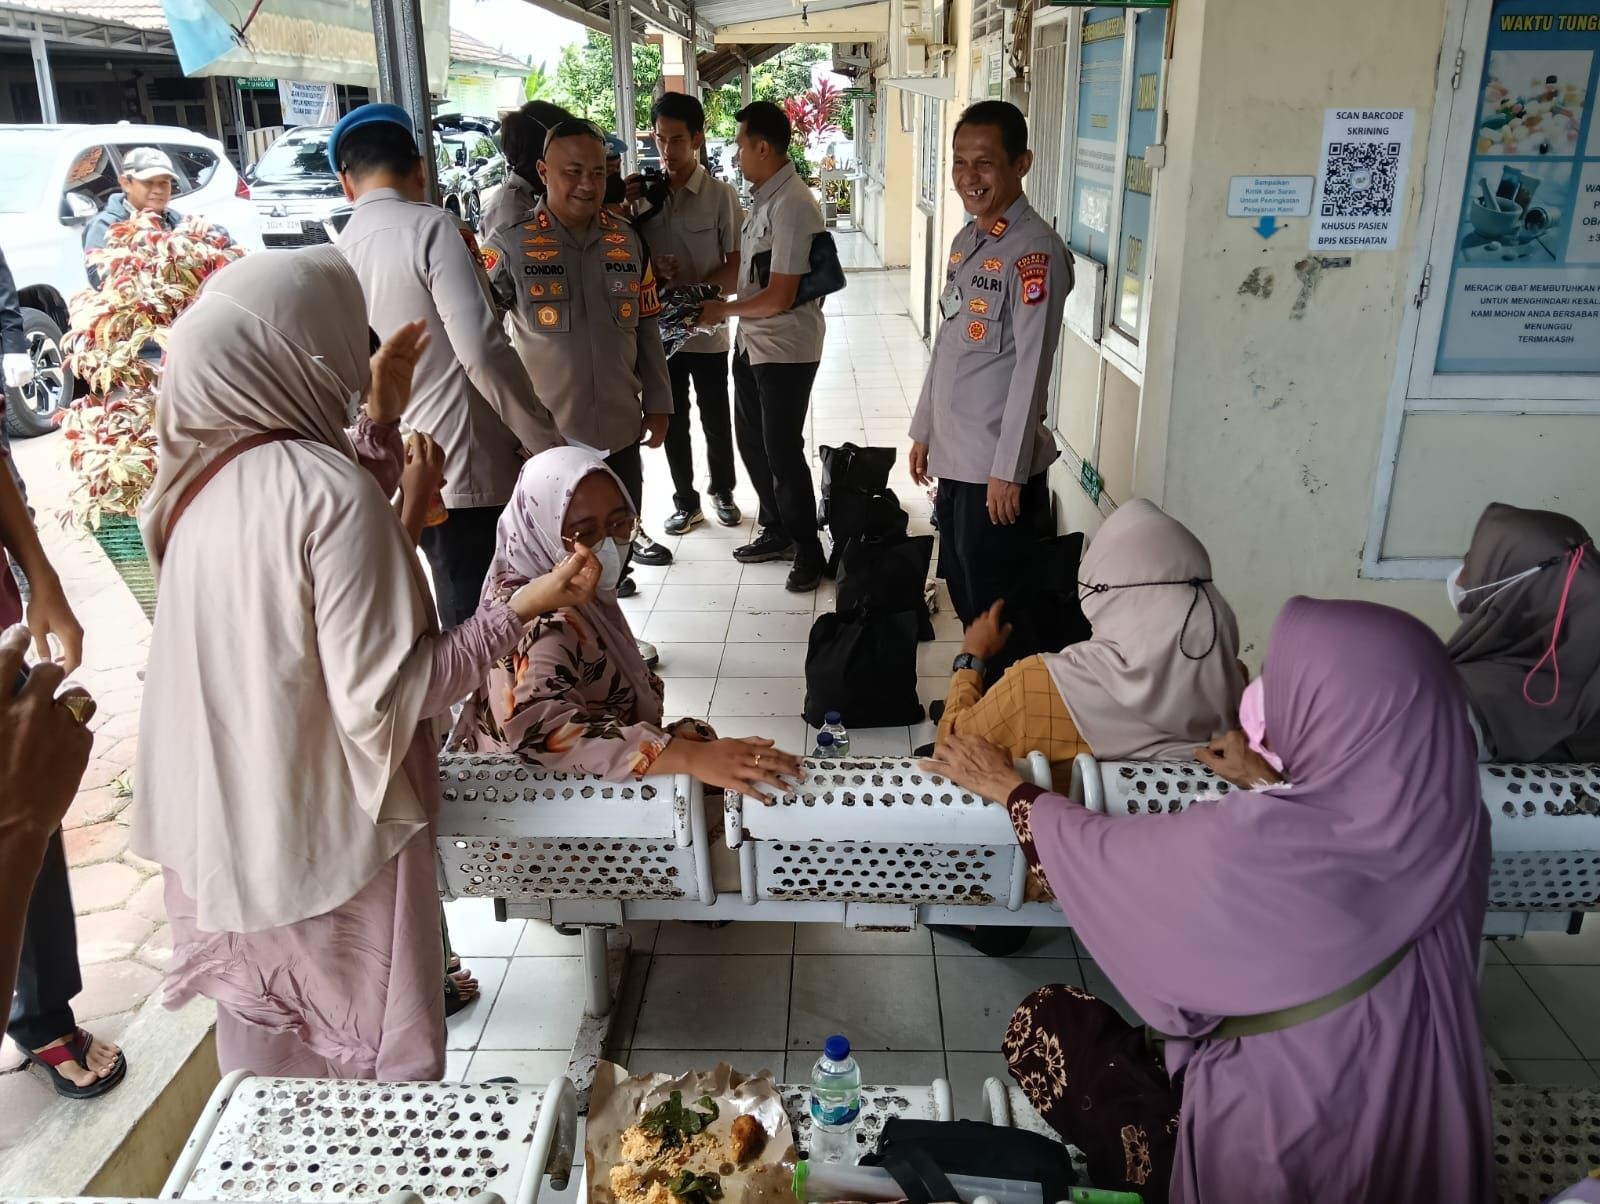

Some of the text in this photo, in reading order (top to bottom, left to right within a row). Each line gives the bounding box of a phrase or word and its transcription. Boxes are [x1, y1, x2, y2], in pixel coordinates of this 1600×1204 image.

[1501, 15, 1600, 31] WAKTU TUNG
[1336, 111, 1404, 120] SCAN BARCODE
[1347, 127, 1390, 136] SKRINING
[1321, 222, 1388, 230] KHUSUS PASIEN
[1582, 217, 1600, 226] OB
[1318, 236, 1388, 245] BPJS KESEHATAN
[524, 265, 564, 275] CONDRO
[606, 263, 637, 273] POLRI
[971, 275, 1003, 292] POLRI
[1464, 284, 1503, 292] MERACIK
[1504, 284, 1529, 292] OBAT
[1529, 284, 1595, 292] MEMBUTUHKAN
[1480, 297, 1600, 305] UNTUK MENGHINDARI KESAL
[1494, 310, 1526, 318] MOHON
[1527, 310, 1551, 318] ANDA
[1552, 310, 1599, 318] BERSABAR
[1518, 335, 1575, 343] TERIMAKASIH
